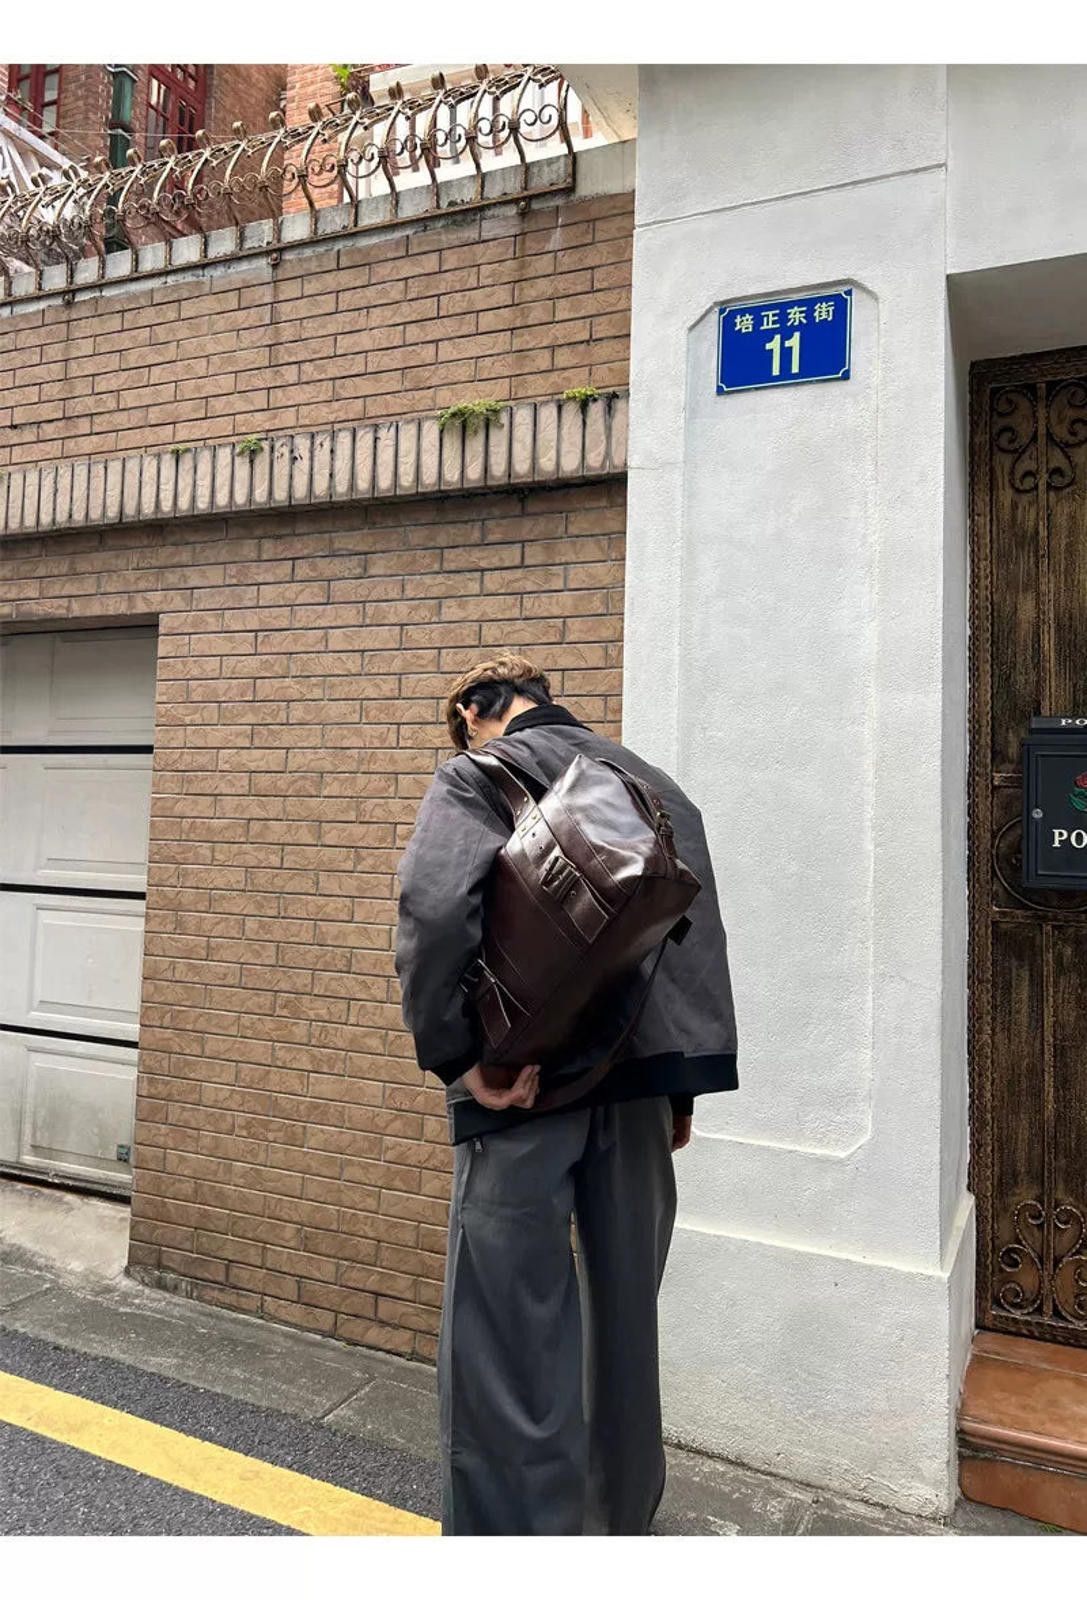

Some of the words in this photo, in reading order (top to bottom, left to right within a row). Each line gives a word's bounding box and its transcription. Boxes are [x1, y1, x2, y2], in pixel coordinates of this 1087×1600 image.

[734, 301, 835, 333] 培正东街
[765, 331, 801, 376] 11
[1052, 829, 1087, 848] PO
